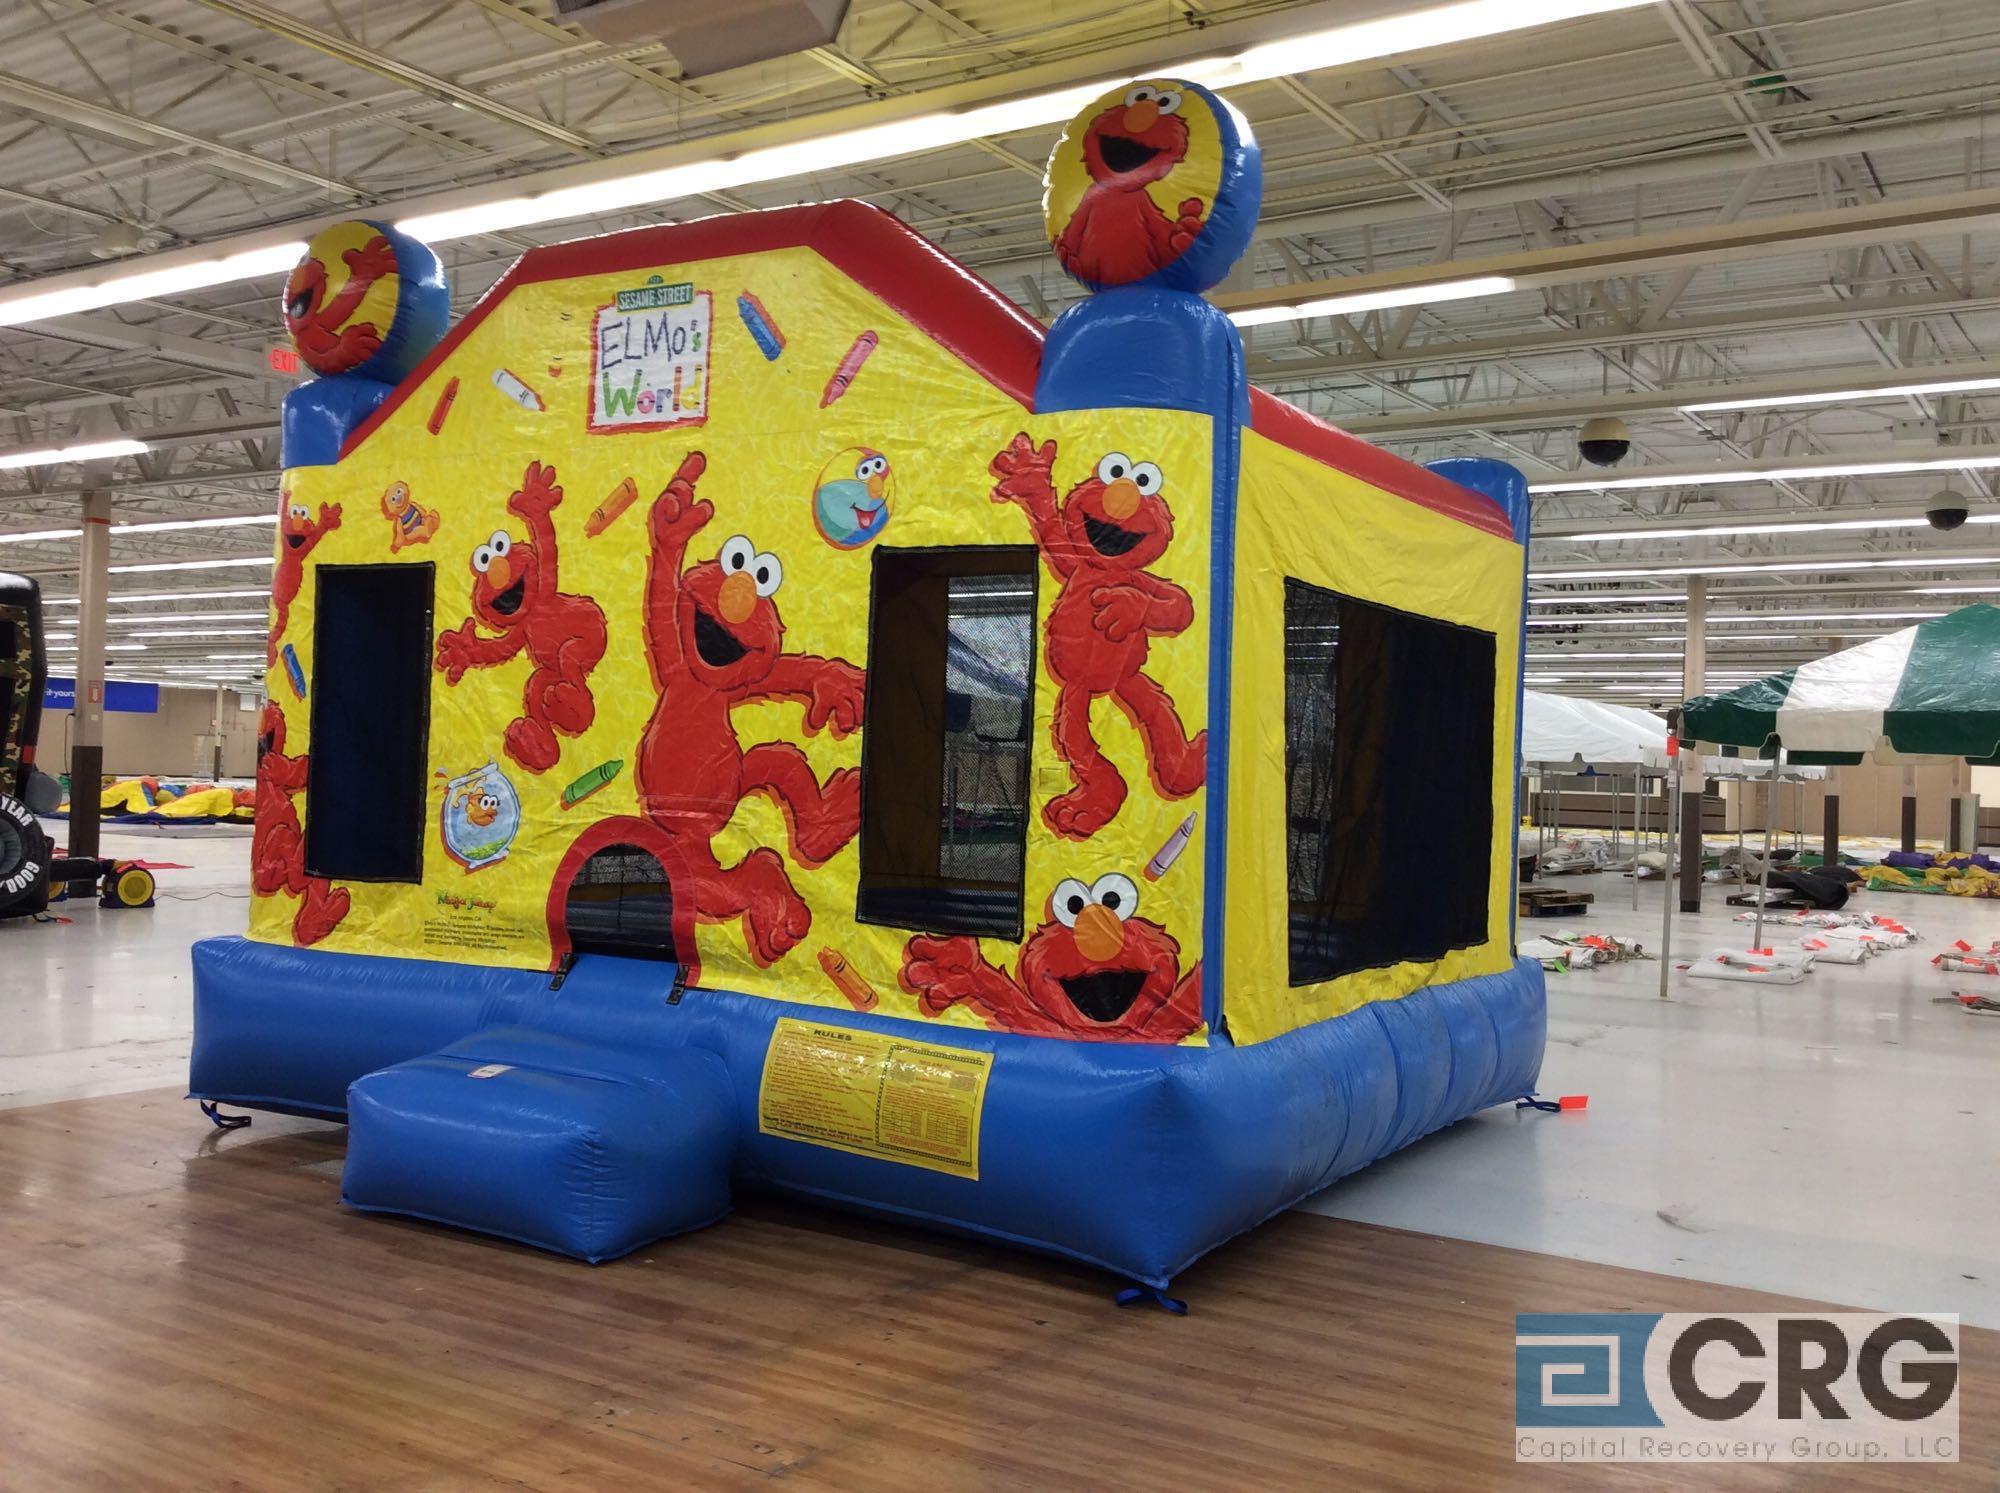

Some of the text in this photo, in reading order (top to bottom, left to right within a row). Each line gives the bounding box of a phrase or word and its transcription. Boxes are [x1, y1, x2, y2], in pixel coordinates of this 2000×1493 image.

[619, 284, 693, 311] SESAME STREET
[272, 348, 298, 373] EXIT
[602, 365, 703, 418] World
[813, 1029, 853, 1042] RULES
